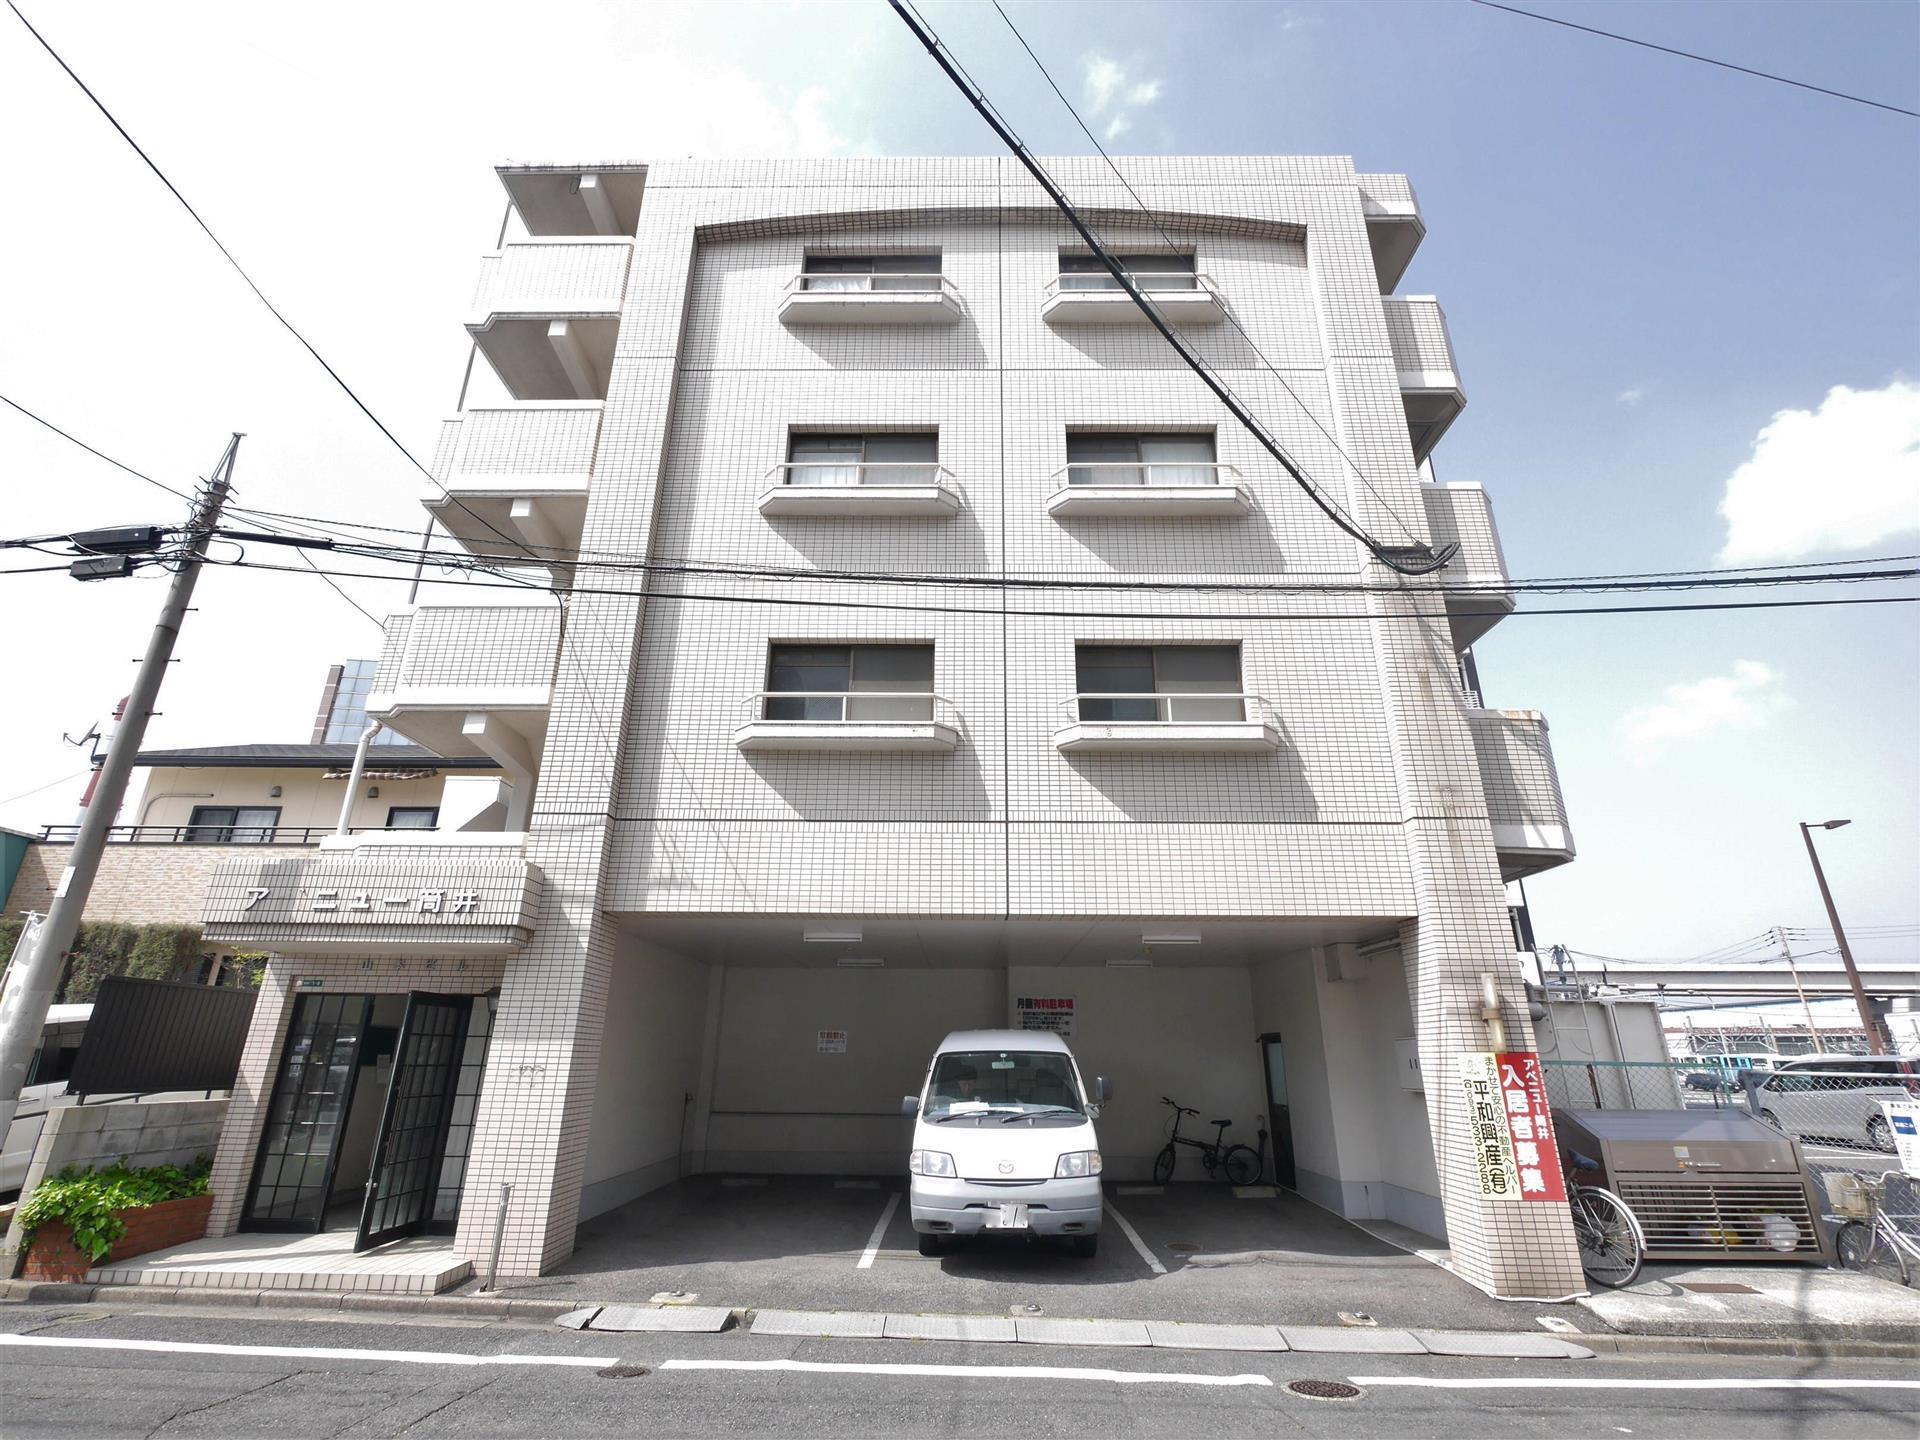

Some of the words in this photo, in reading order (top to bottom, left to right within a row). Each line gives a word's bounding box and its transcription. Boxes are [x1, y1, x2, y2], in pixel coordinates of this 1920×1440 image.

[1501, 1064, 1546, 1193] 入居者募集
